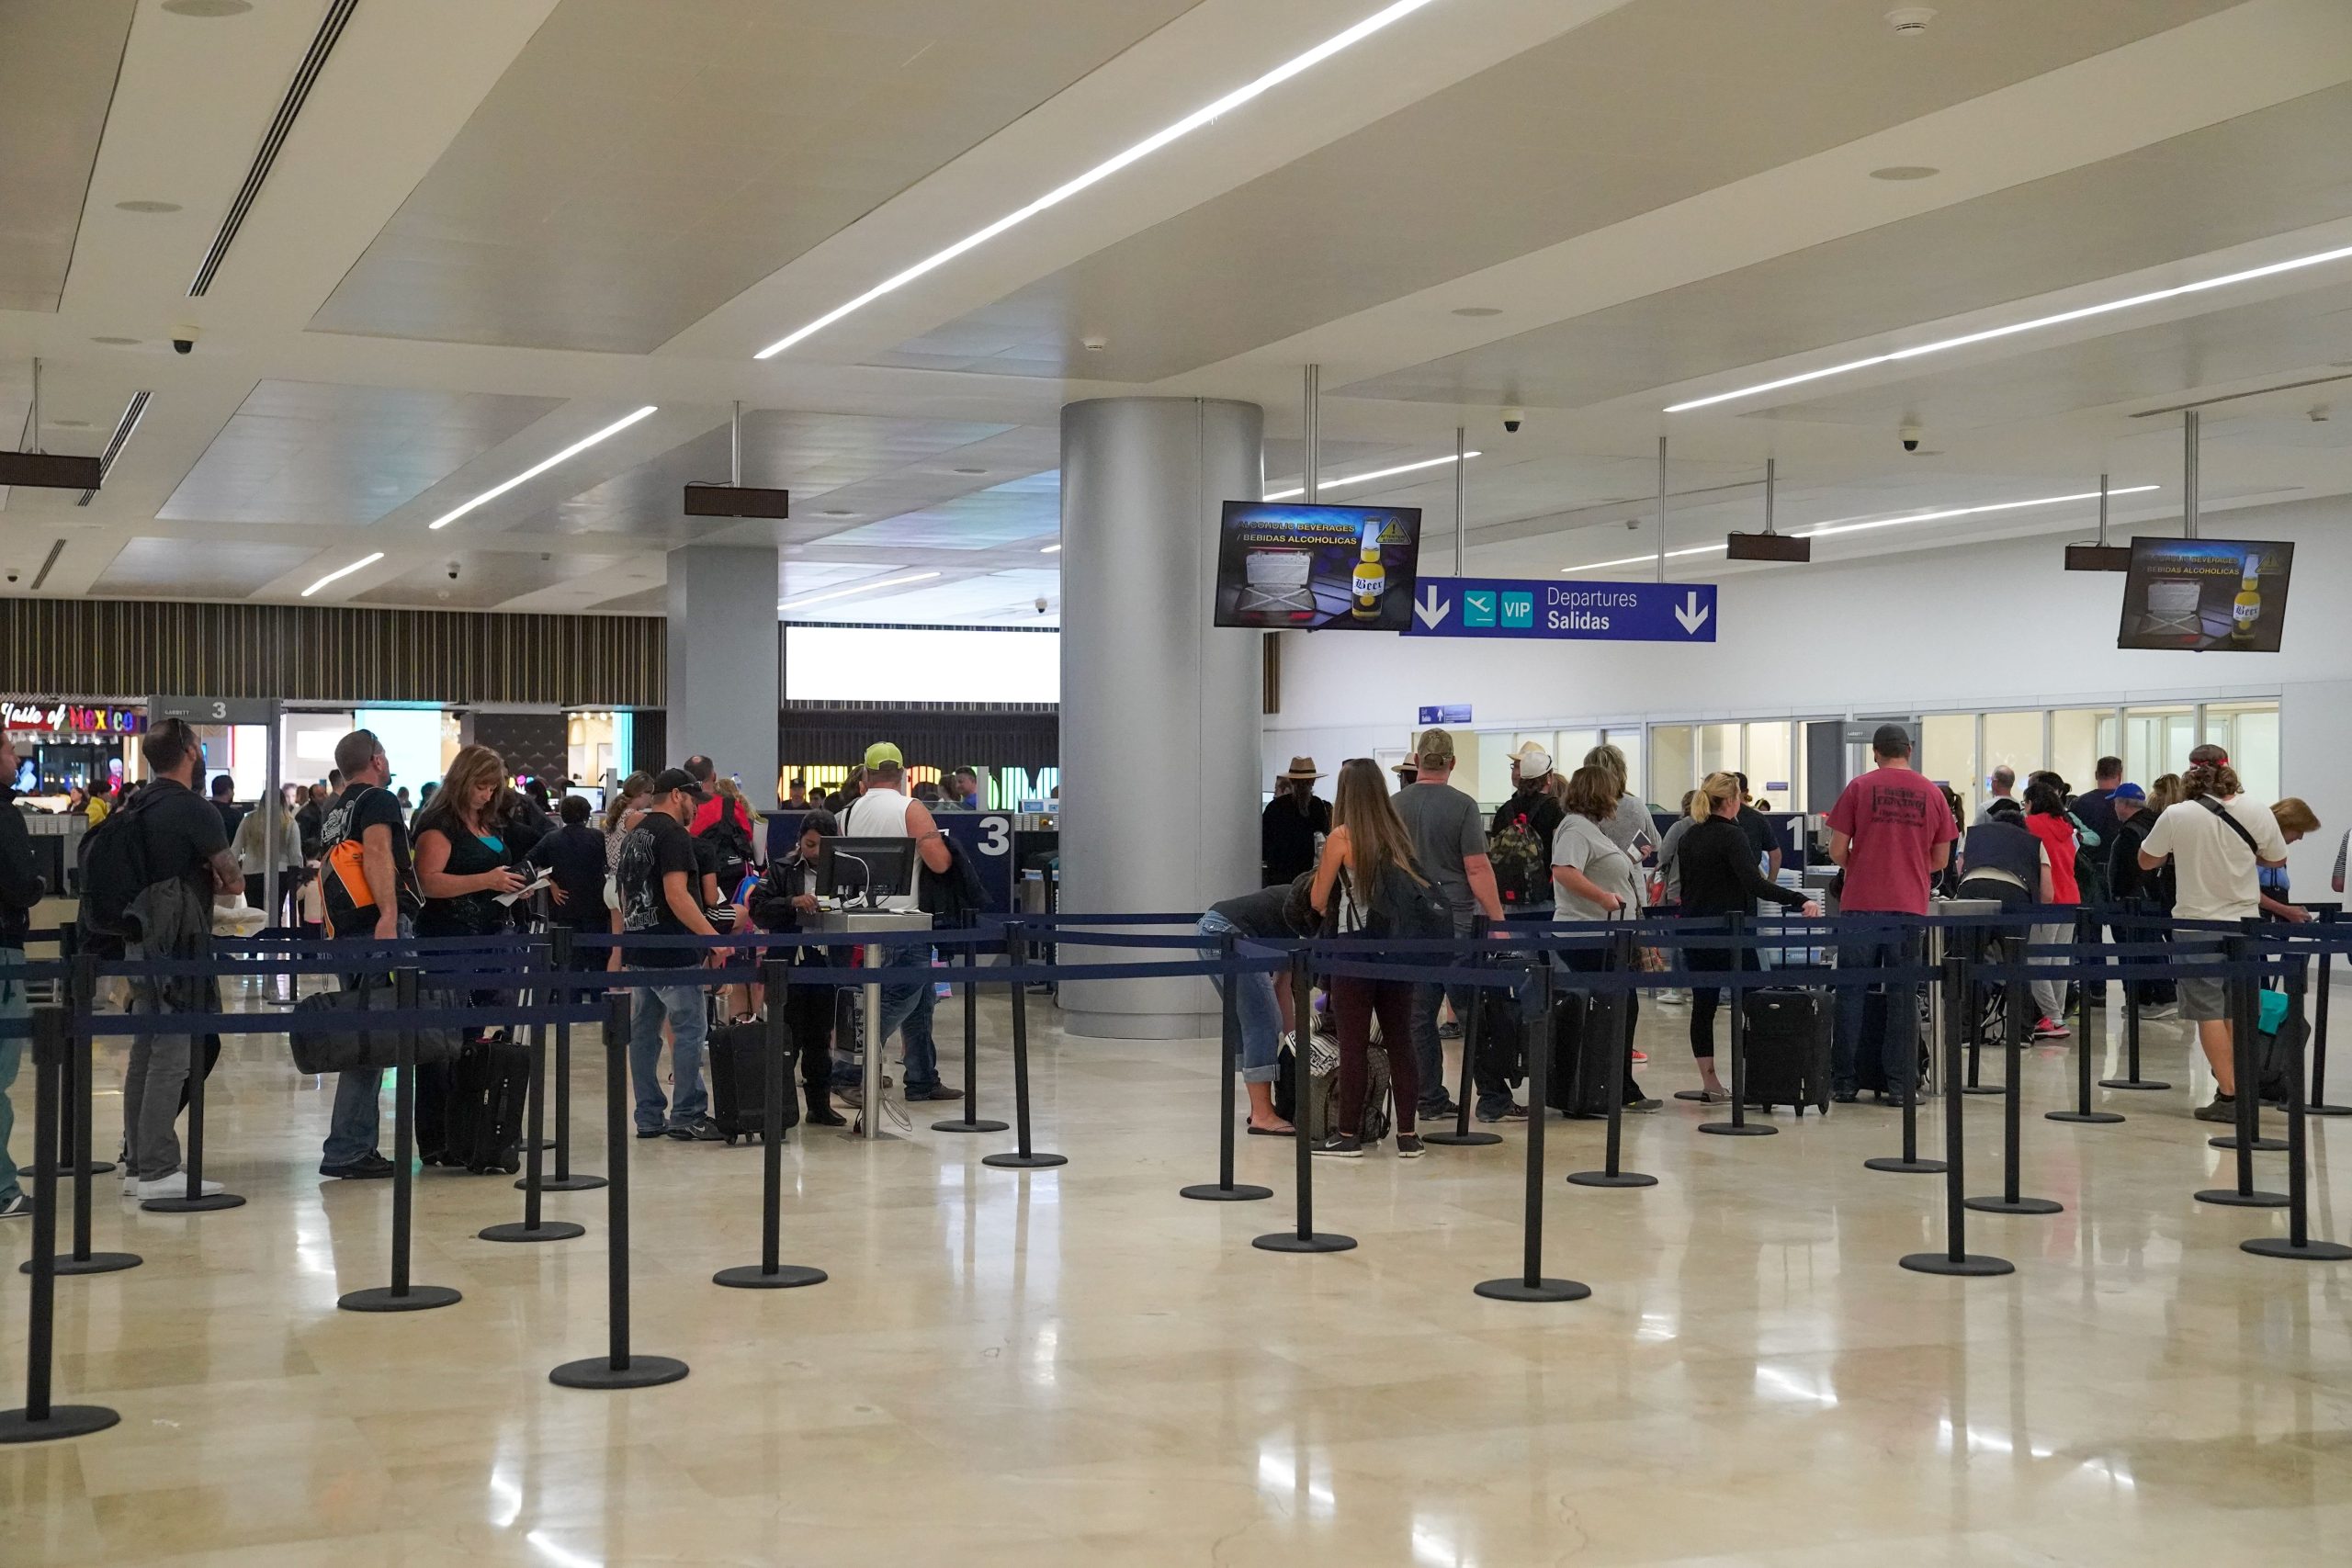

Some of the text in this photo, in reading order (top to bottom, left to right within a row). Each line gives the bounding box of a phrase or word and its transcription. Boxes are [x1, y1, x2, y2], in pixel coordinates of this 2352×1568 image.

[1238, 521, 1356, 533] ALCOHOLIC BEVERAGES
[1243, 534, 1286, 543] BEBIDAS
[1288, 536, 1357, 546] ALCOHOLICAS
[2146, 566, 2182, 574] BEBIDAS
[2183, 566, 2240, 576] ALCOHOLICAS
[1354, 578, 1383, 592] Beer
[1547, 587, 1638, 610] Departures
[1504, 602, 1531, 618] VIP
[1547, 610, 1611, 630] Salidas
[1, 702, 43, 728] Taste
[47, 704, 66, 731] of
[211, 702, 227, 719] 3
[978, 816, 1010, 856] 3
[1786, 816, 1804, 851] 1
